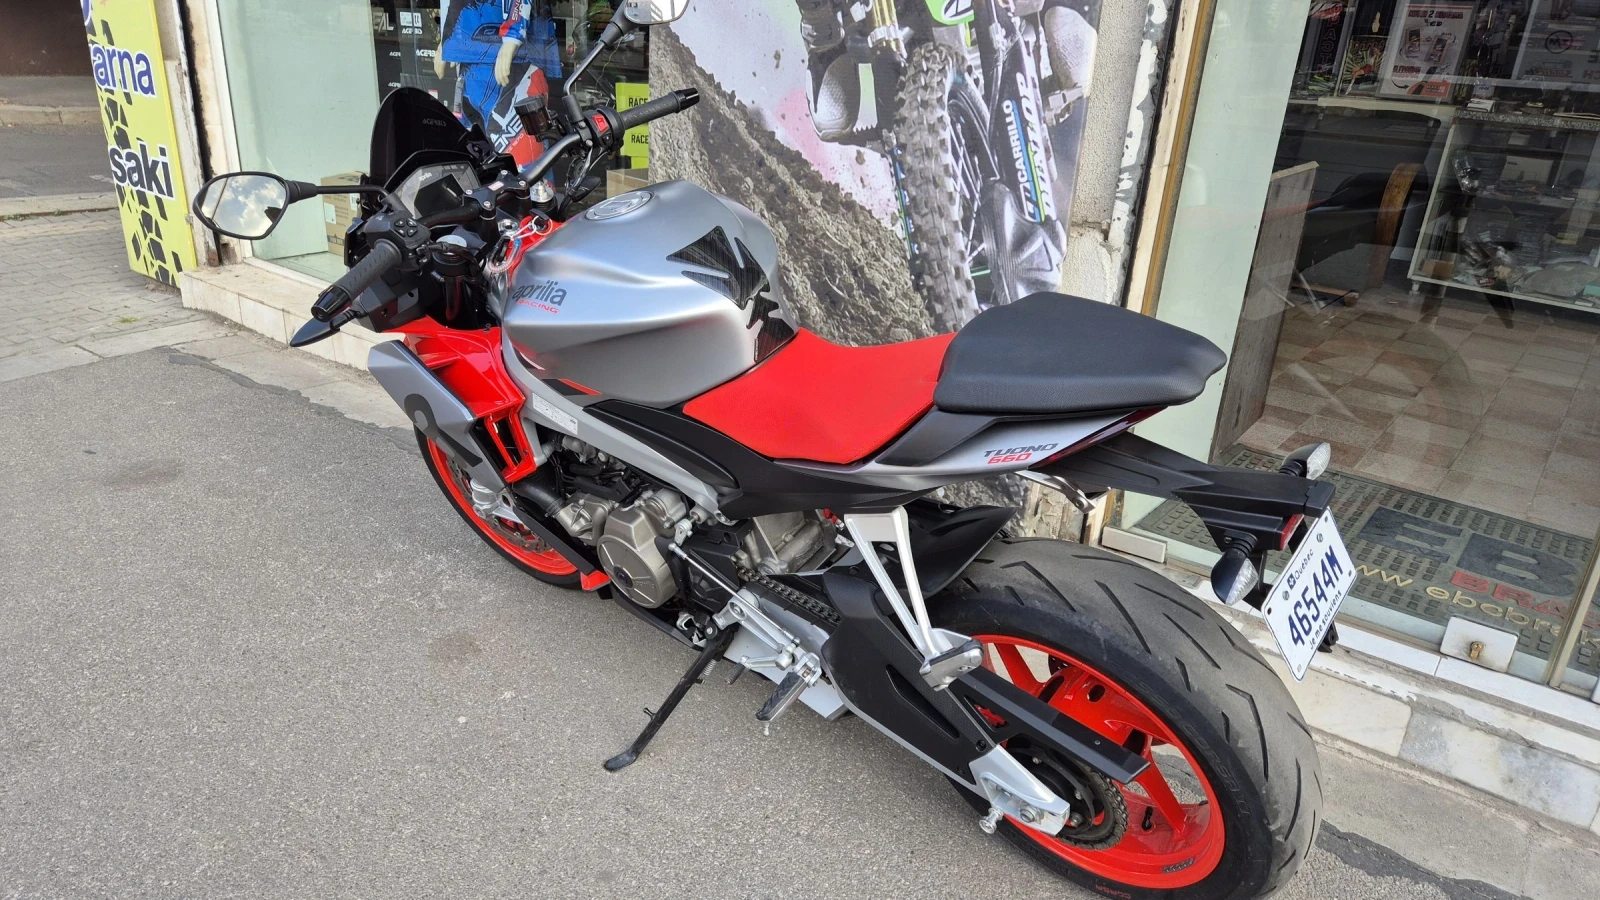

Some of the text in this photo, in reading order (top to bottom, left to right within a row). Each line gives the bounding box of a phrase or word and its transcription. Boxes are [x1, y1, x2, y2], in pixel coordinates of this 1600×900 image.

[1002, 98, 1029, 183] CARRILLO
[512, 279, 568, 307] aprilia
[516, 298, 560, 314] RACING
[983, 442, 1059, 458] TUONO
[987, 452, 1033, 465] 660
[1294, 548, 1315, 581] Québec
[1287, 544, 1344, 648] 46544M
[1321, 591, 1343, 626] souviens
